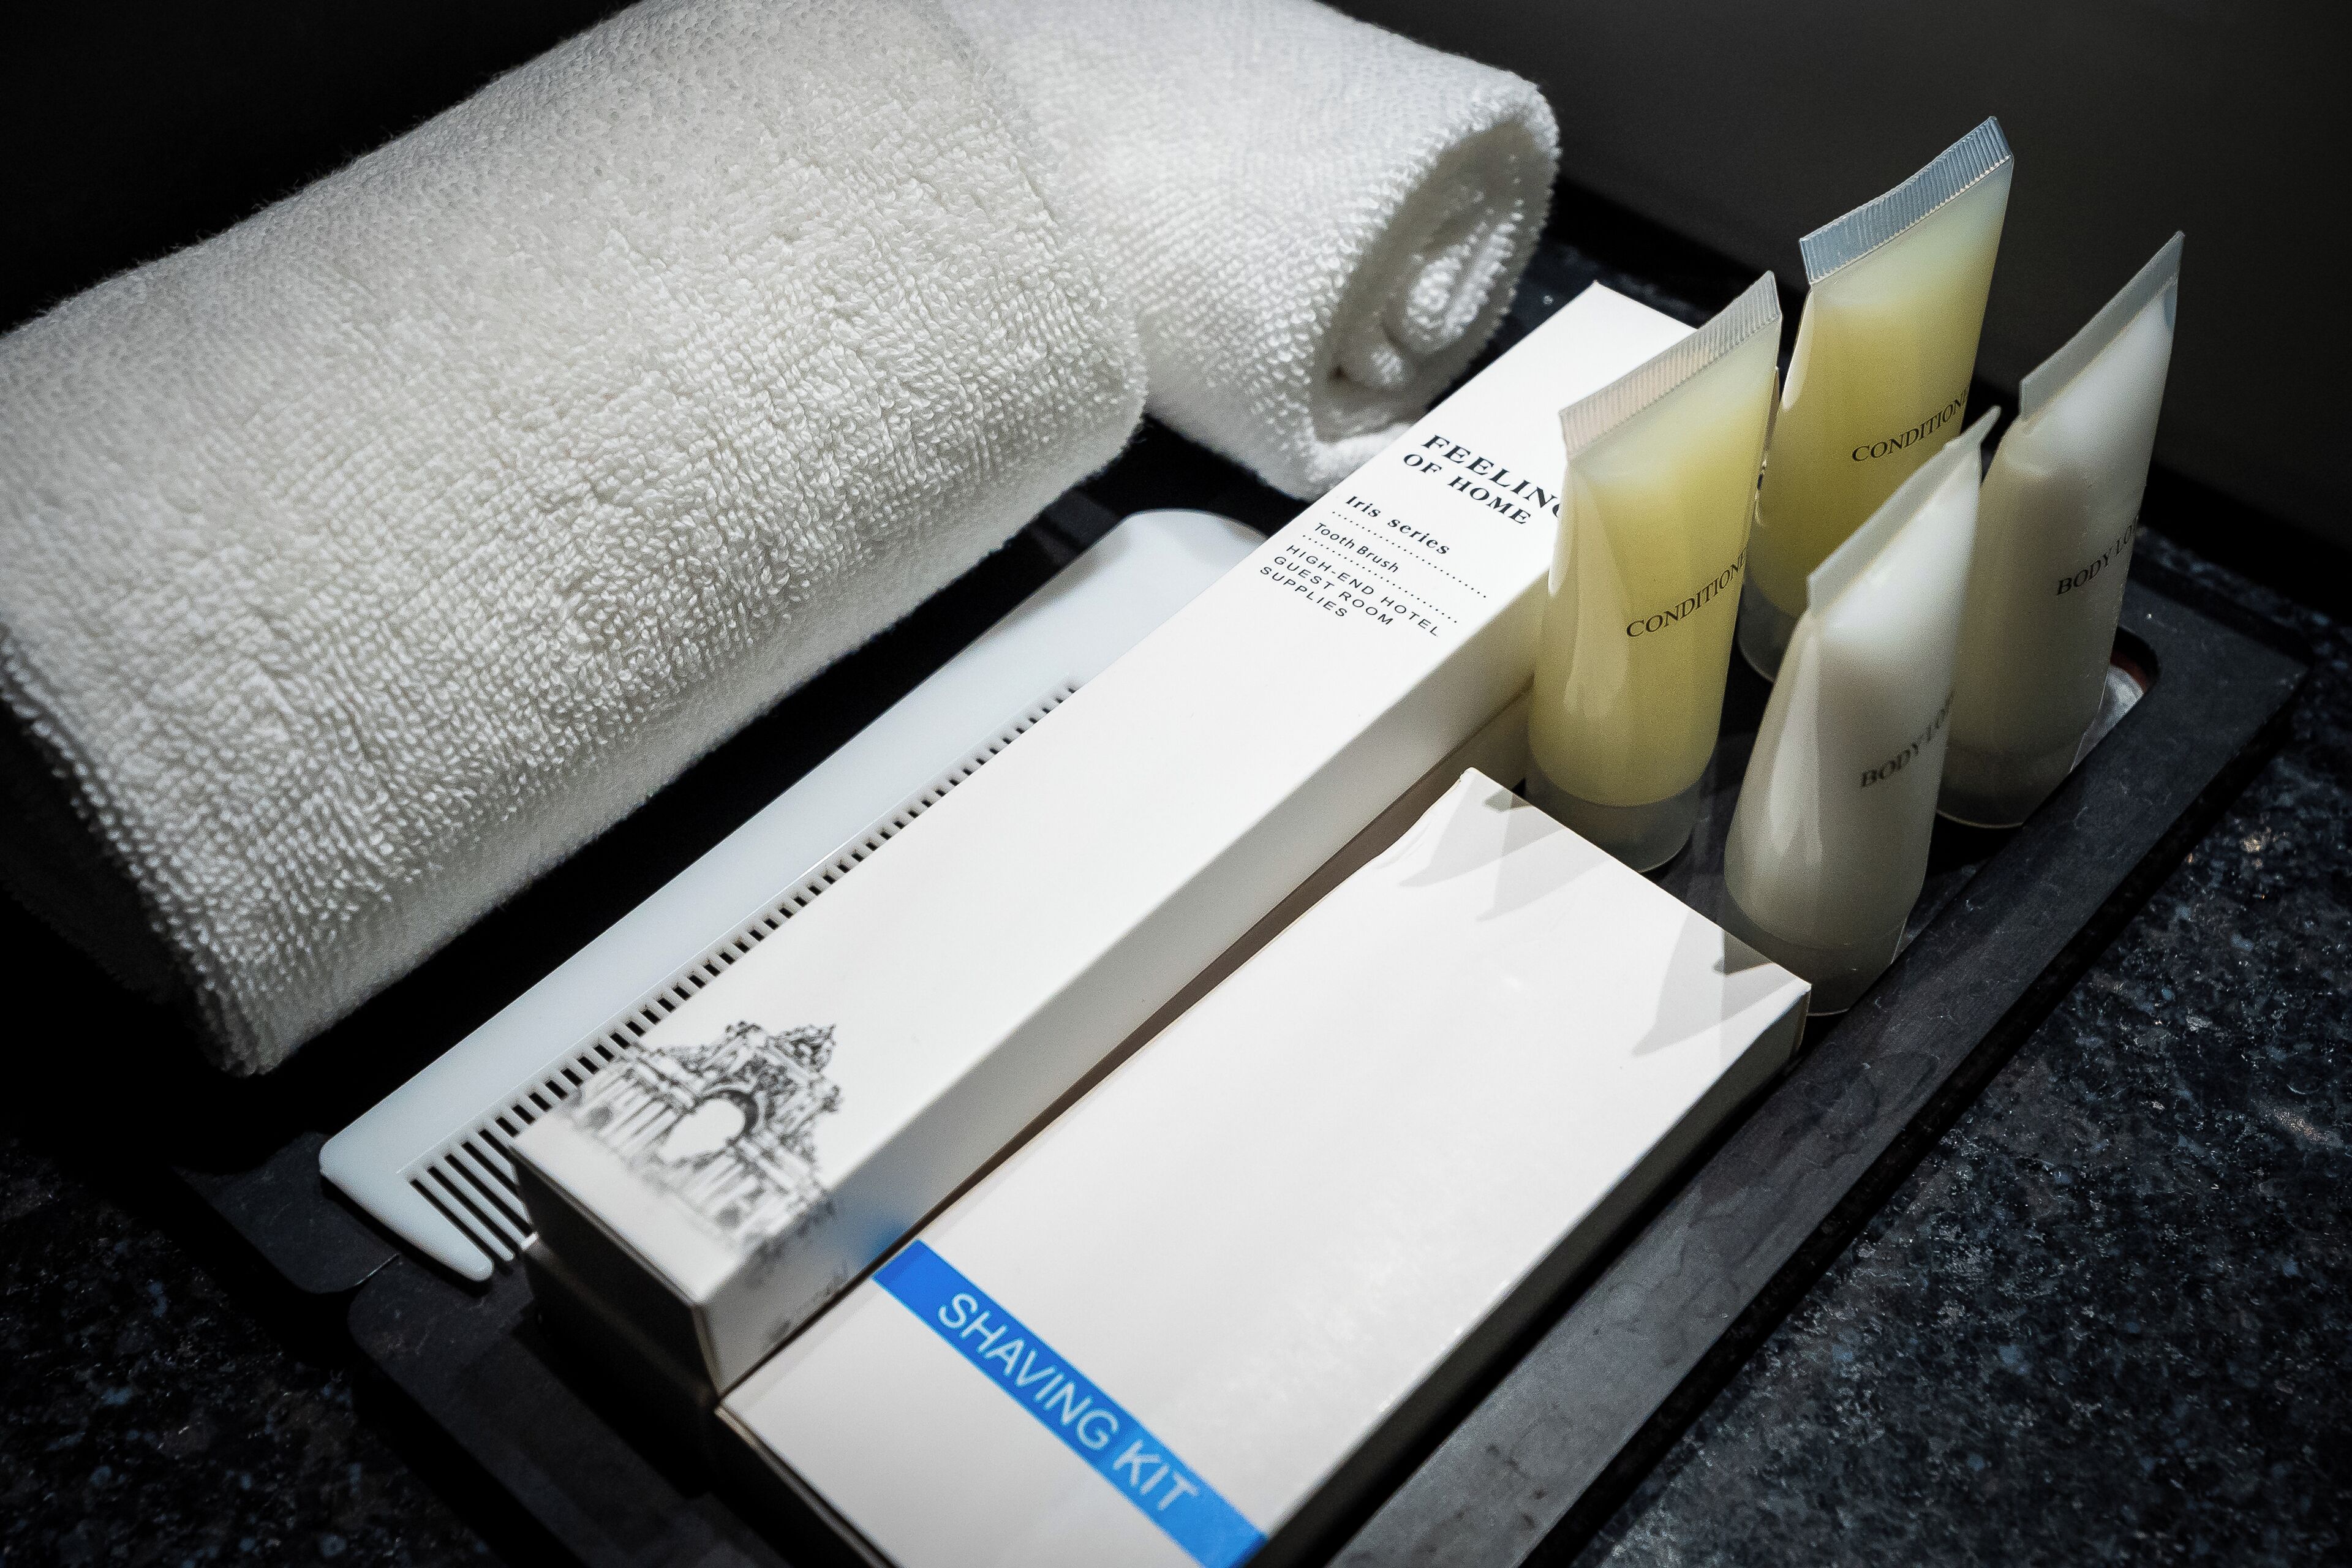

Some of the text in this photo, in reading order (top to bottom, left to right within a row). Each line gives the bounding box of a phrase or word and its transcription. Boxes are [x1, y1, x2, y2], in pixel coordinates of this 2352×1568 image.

[1403, 453, 1531, 525] OF HOME
[1314, 523, 1399, 573] Tooth Brush
[1345, 496, 1450, 555] Iris series
[1260, 567, 1348, 618] SUPPLIES
[1274, 556, 1394, 625] GUEST ROOM
[1286, 545, 1439, 637] HIGH-END HOTEL
[2056, 546, 2113, 596] BODY
[1861, 735, 1924, 788] BODY
[938, 1292, 1200, 1510] SHAVING KIT
